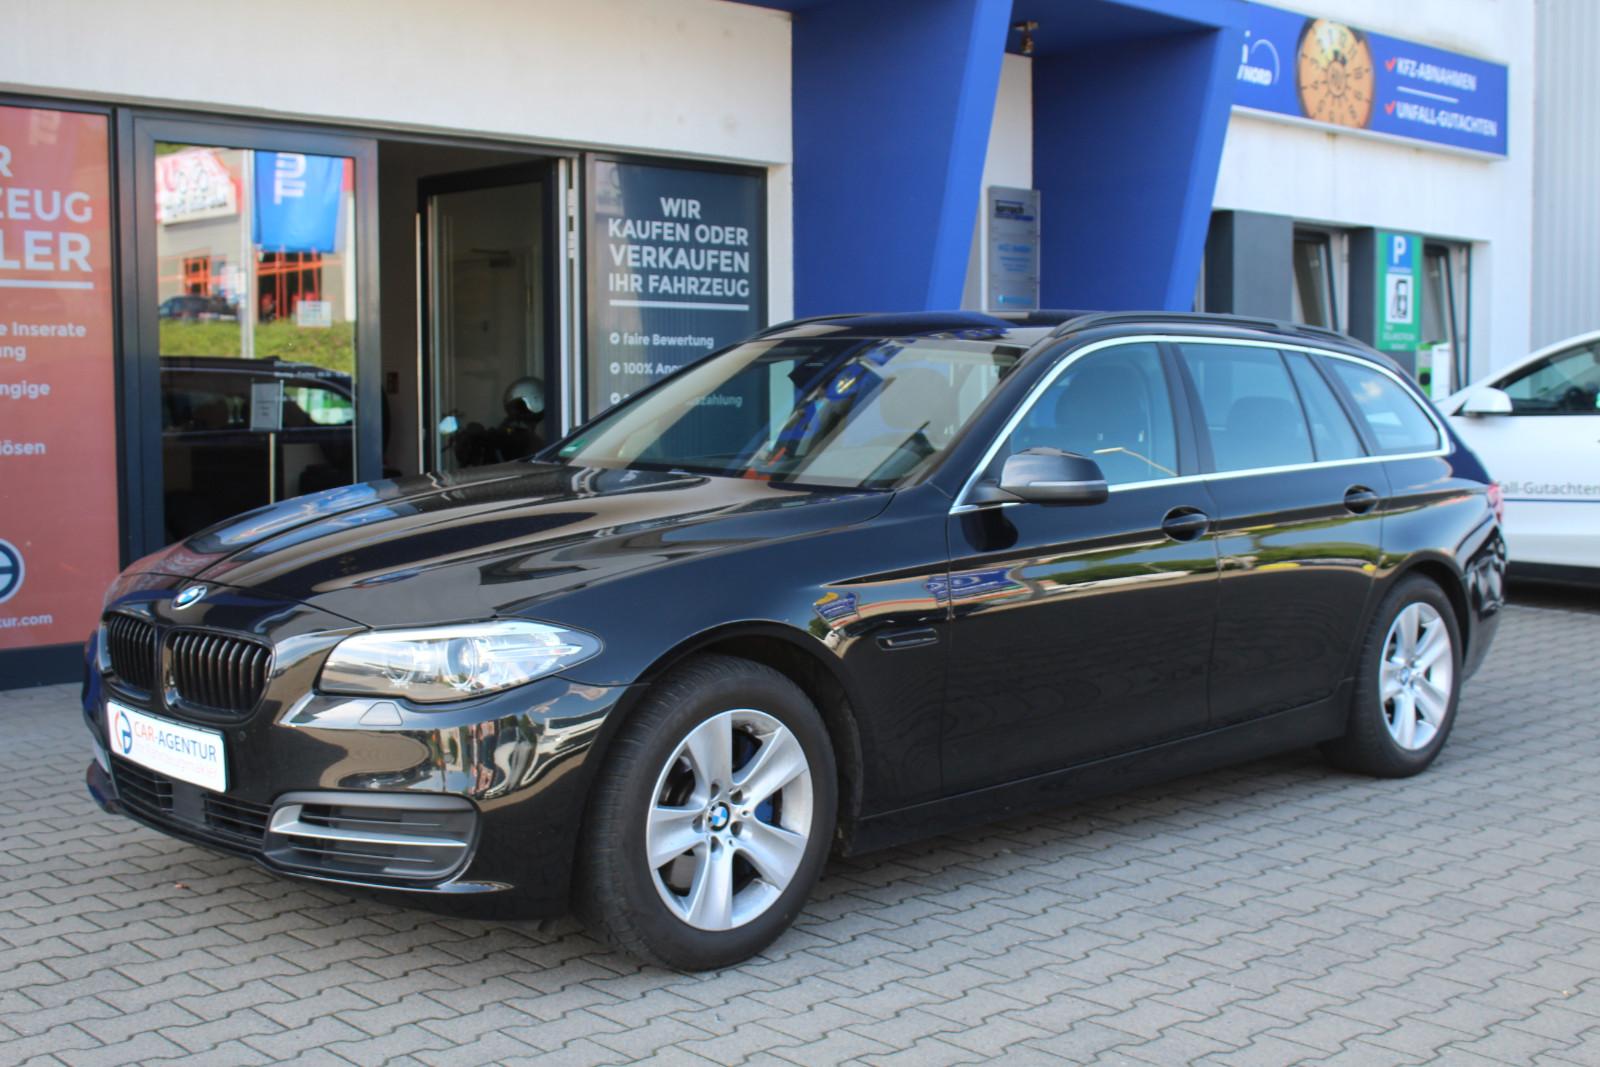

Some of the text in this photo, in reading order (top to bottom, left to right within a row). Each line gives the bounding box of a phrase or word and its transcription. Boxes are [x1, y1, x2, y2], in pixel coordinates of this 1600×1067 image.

[1396, 57, 1477, 92] KFZ-ABNAHMEN
[1396, 101, 1498, 138] UNFALL-GUTACHTEN
[660, 196, 701, 220] WIR
[608, 217, 749, 247] KAUFEN ODER
[608, 242, 750, 274] VERKAUFEN
[1392, 235, 1407, 265] P
[608, 272, 750, 298] IHR FAHRZEUG
[13, 321, 87, 338] Inserate
[623, 333, 714, 350] faire Bewertung
[623, 362, 653, 375] 100%
